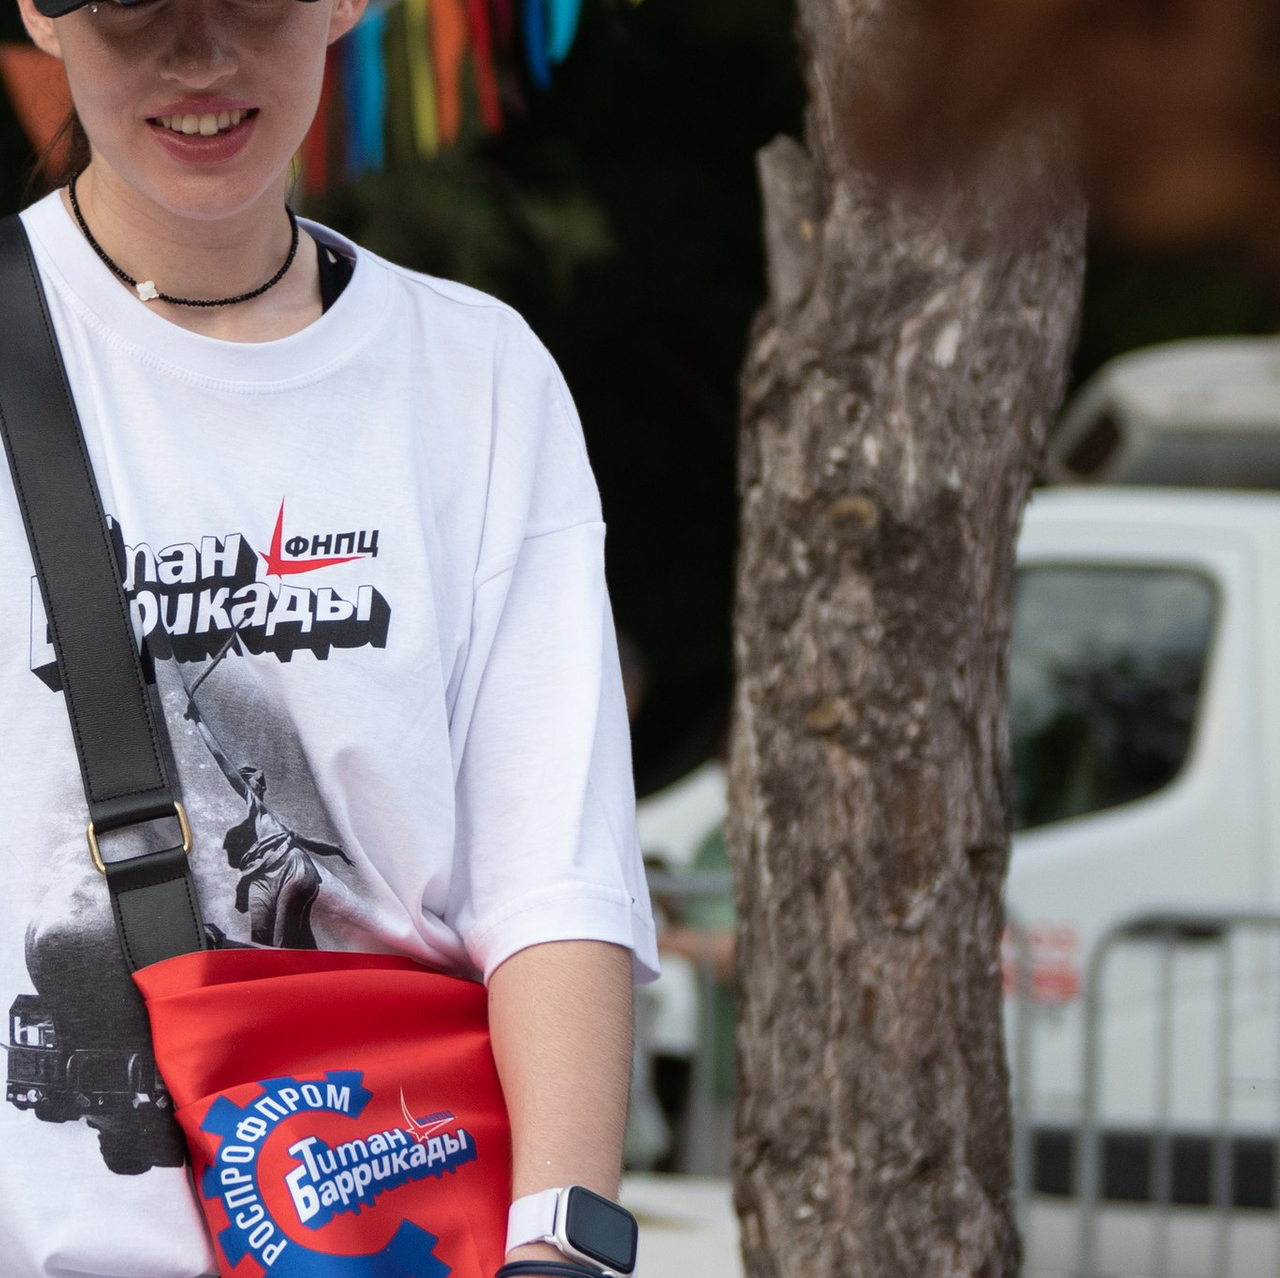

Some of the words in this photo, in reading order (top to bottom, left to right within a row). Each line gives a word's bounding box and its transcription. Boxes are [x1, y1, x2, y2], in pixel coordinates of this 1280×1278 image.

[105, 513, 244, 590] тан
[284, 530, 379, 558] ФНПЦ
[31, 575, 380, 672] рикады
[222, 1083, 351, 1267] РОСПРОФПРОМ
[284, 1128, 468, 1224] Баррикады
[288, 1127, 408, 1183] Титан
